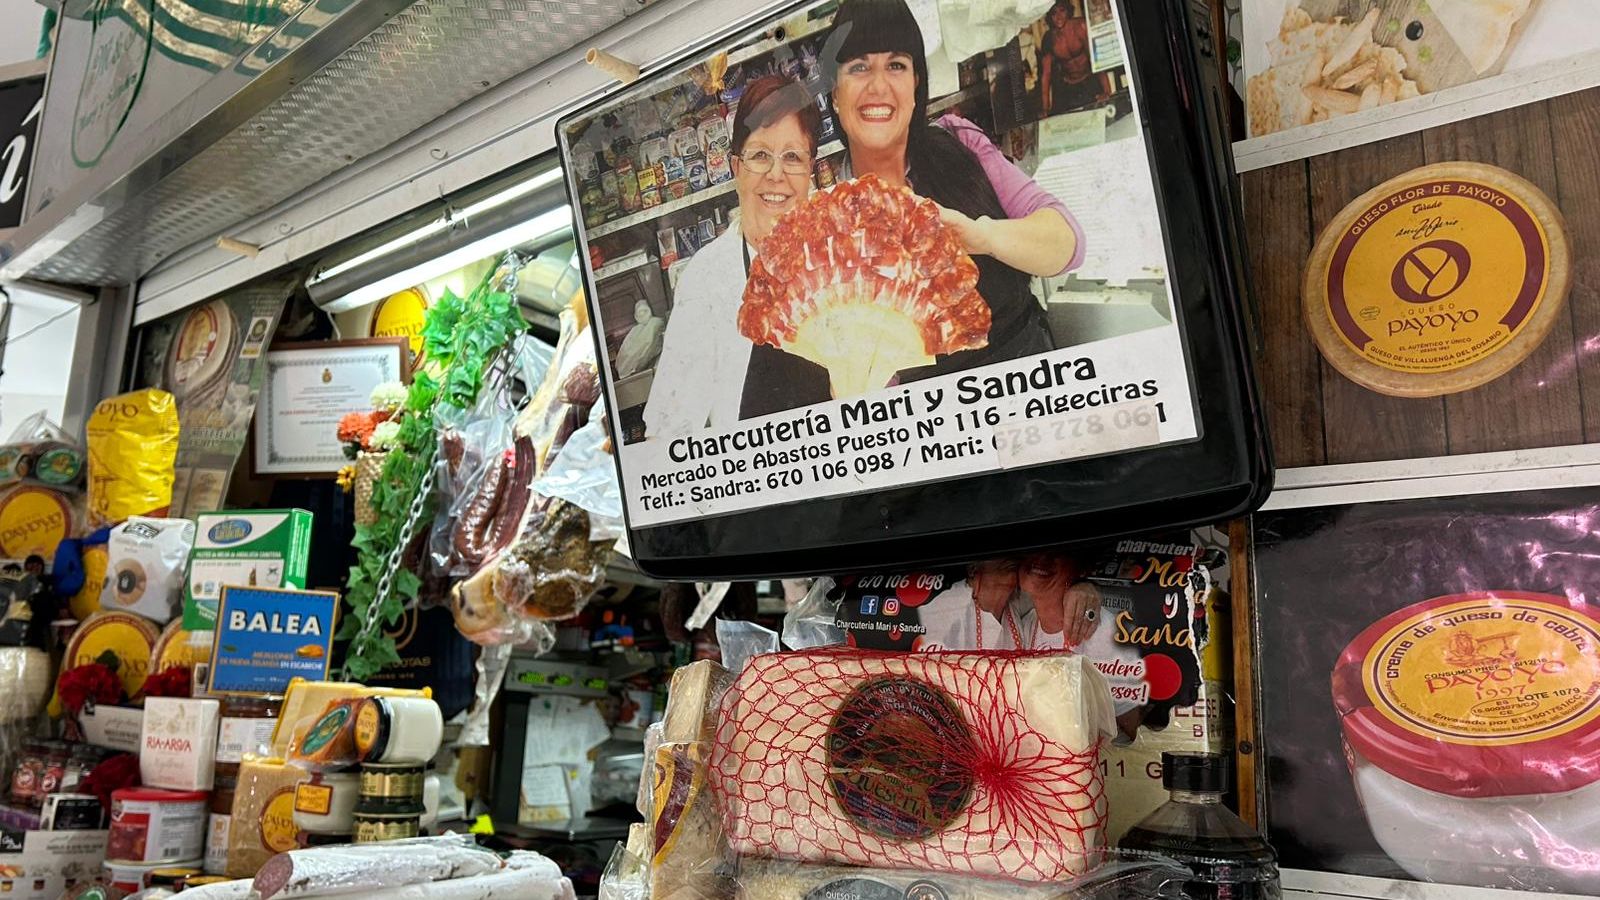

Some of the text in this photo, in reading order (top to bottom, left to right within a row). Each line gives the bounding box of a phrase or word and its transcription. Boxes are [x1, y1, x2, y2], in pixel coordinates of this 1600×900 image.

[1351, 203, 1388, 236] QUESO
[1391, 187, 1425, 206] FLOR
[1433, 184, 1451, 195] DE
[1457, 185, 1507, 208] PAYOYO
[1408, 303, 1456, 315] QUESO
[1388, 309, 1479, 337] PAYOYO
[1370, 345, 1392, 359] QUESO
[1393, 354, 1403, 362] DE
[1404, 355, 1455, 363] VILLALUENGA
[1456, 349, 1470, 358] DEL
[1471, 330, 1502, 351] ROSARIO
[668, 356, 1097, 463] Charcutería Mari y Sandra
[641, 464, 717, 490] Mercado
[722, 458, 747, 476] De
[753, 443, 831, 470] Abastos
[837, 427, 910, 453] Puesto
[955, 407, 1001, 432] 116
[1025, 379, 1159, 419] Algeciras
[640, 492, 685, 511] Telf.:
[690, 476, 761, 503] Sandra:
[766, 469, 803, 490] 670
[811, 460, 848, 483] 106
[854, 451, 895, 474] 098
[902, 447, 912, 467] /
[920, 437, 984, 463] Mari:
[1050, 416, 1104, 441] 778
[1113, 402, 1167, 430] 061
[885, 575, 910, 589] 106
[917, 574, 944, 590] 098
[1165, 592, 1180, 619] y
[229, 609, 322, 637] BALEA
[876, 621, 891, 631] Mari
[892, 624, 898, 634] y
[899, 623, 926, 633] Sandra
[1414, 625, 1436, 639] de
[1442, 611, 1503, 628] queso
[1512, 610, 1539, 624] de
[1424, 669, 1472, 680] CONSUMO
[1424, 660, 1566, 694] PAYOYO
[1474, 685, 1527, 701] 1997
[1516, 692, 1550, 703] LOTE
[1434, 712, 1486, 725] Envasado
[826, 891, 850, 900] QUESO
